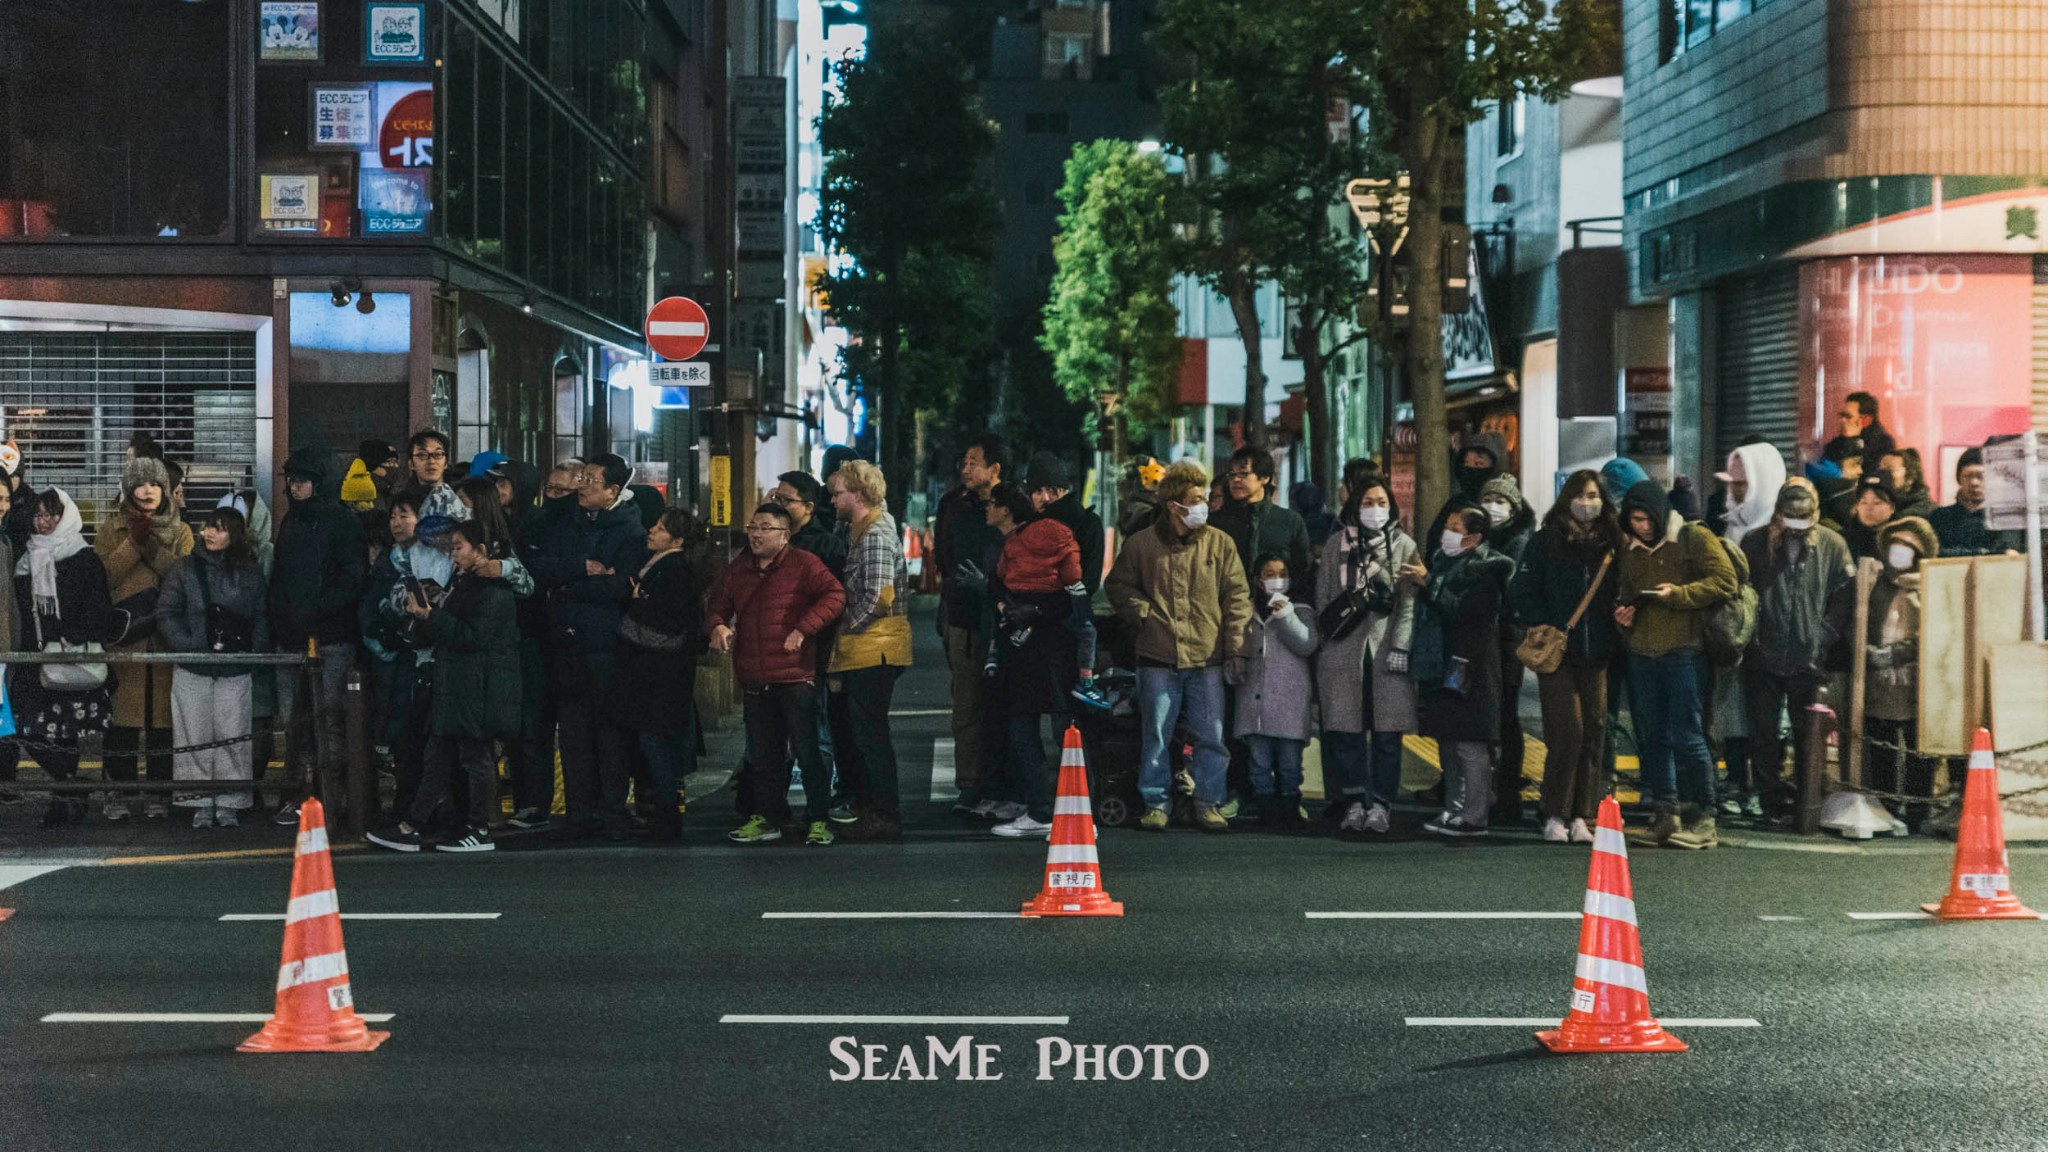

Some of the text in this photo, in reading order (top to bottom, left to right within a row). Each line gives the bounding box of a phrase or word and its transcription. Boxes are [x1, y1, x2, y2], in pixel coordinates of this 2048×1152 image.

[375, 44, 416, 54] ECCジュニア
[319, 93, 368, 104] ECCジュニア
[319, 125, 368, 140] 募集中
[369, 218, 422, 229] ECCジュニア
[650, 366, 707, 381] 自転車を除く
[1051, 872, 1094, 886] 警視庁
